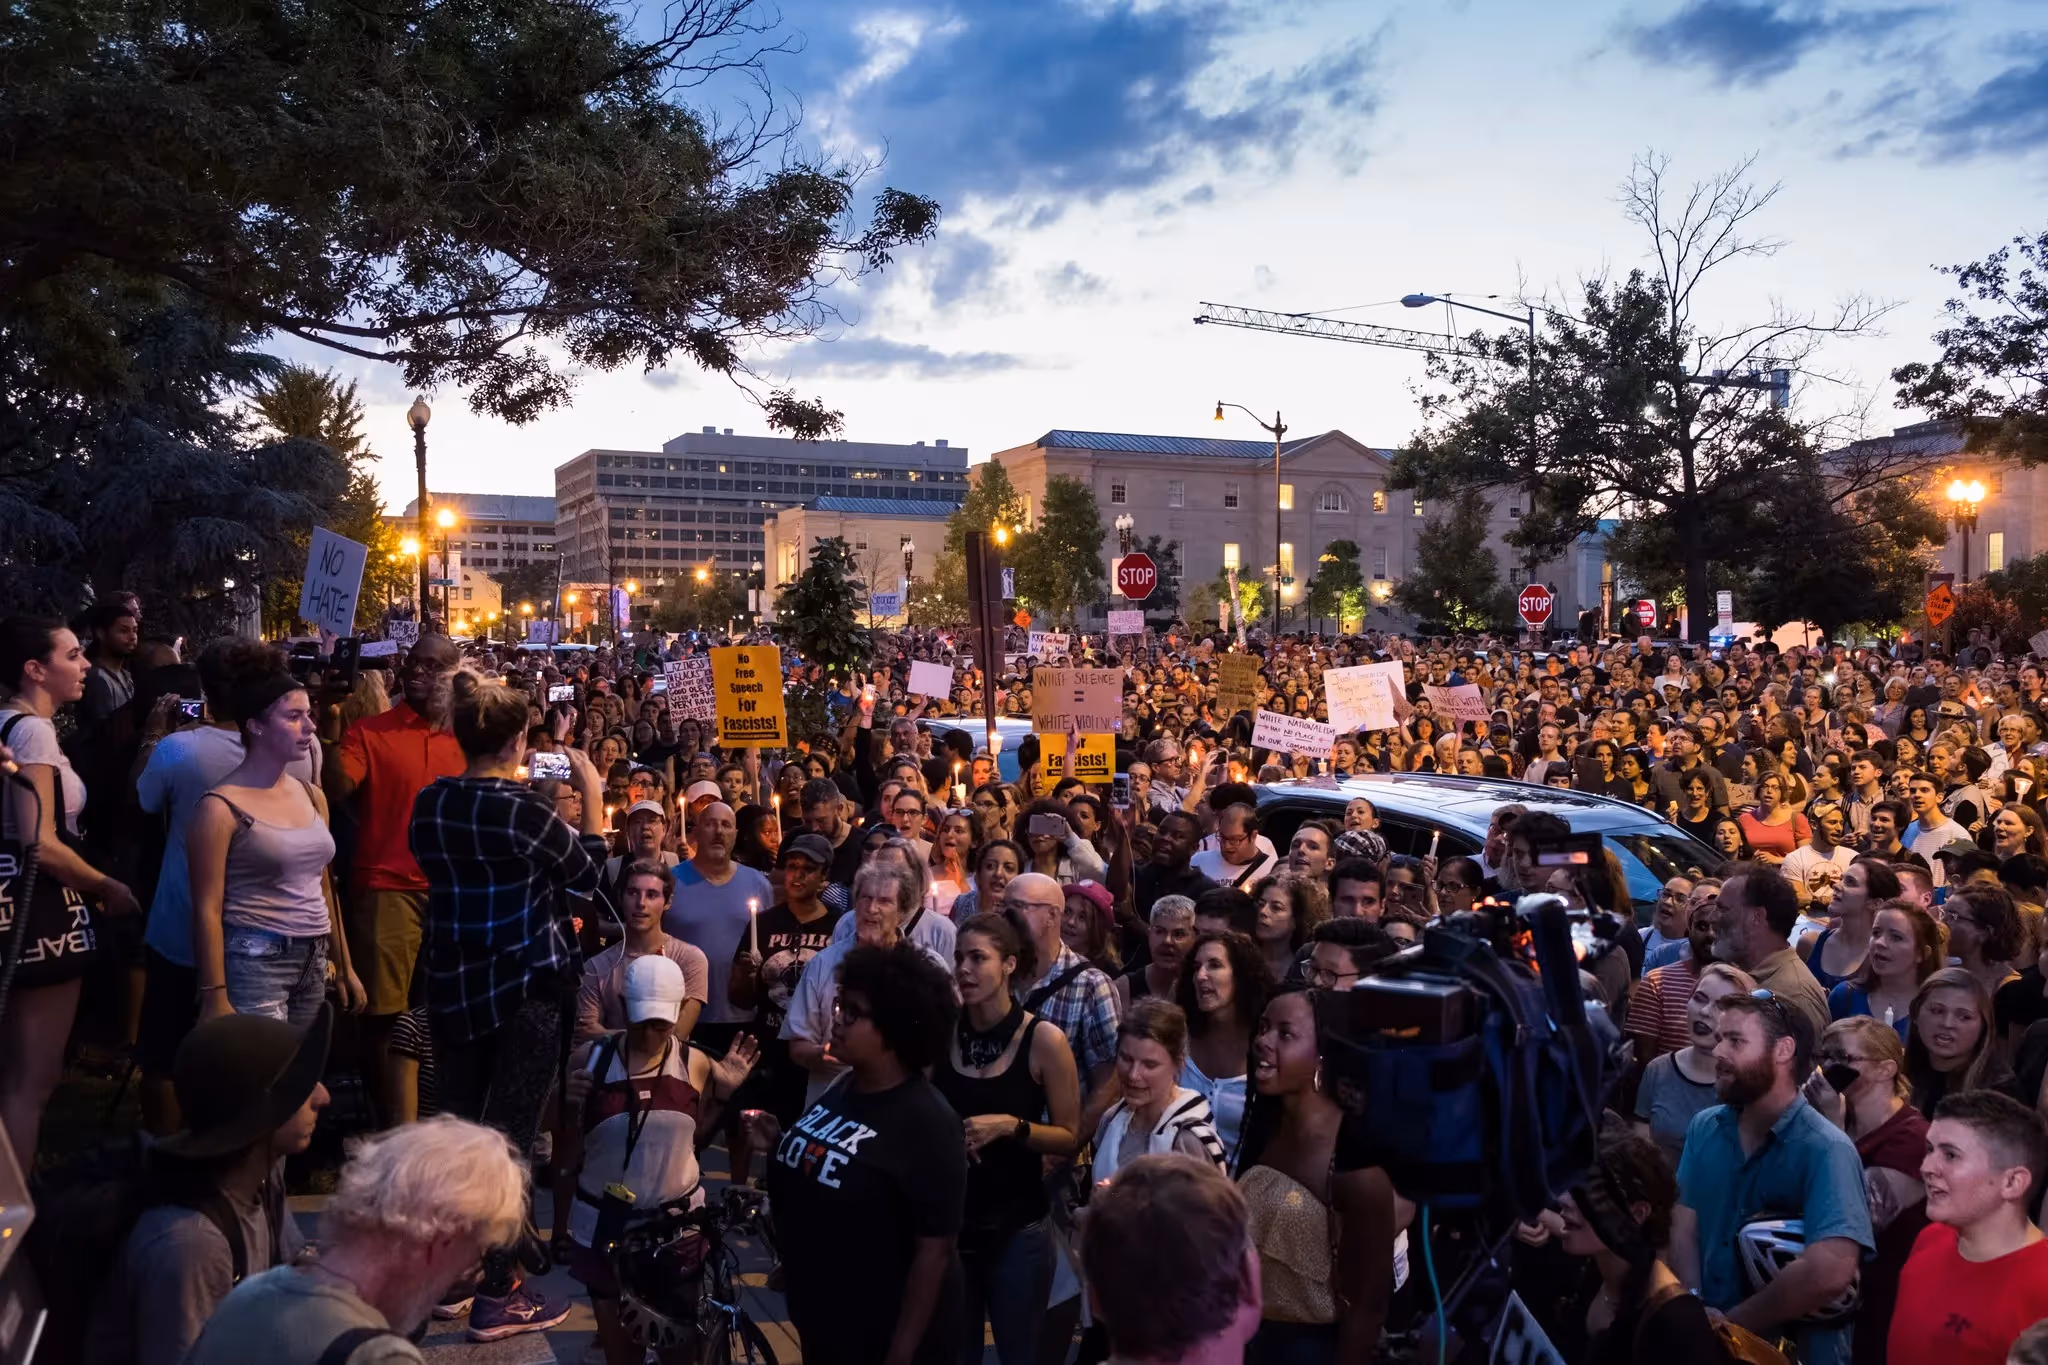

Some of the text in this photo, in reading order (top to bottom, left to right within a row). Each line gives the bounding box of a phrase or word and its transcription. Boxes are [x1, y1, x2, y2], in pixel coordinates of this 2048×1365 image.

[320, 541, 345, 577] NO
[1120, 568, 1153, 585] STOP
[308, 578, 349, 624] HATE
[1522, 597, 1549, 612] STOP
[737, 653, 750, 664] No
[664, 659, 705, 673] LAZINESS
[735, 668, 755, 678] Free
[1073, 671, 1115, 686] SILENCE
[1329, 672, 1351, 685] Just
[669, 688, 686, 696] GOOD
[730, 682, 763, 693] Speech
[1438, 687, 1452, 697] DC
[671, 697, 716, 709] VERY ROUG
[738, 698, 757, 712] For
[1460, 696, 1485, 707] WITH
[723, 716, 777, 730] Fascists!
[1037, 714, 1070, 732] WHITE
[1259, 712, 1336, 737] WHITE NATIONALISM
[1270, 725, 1280, 733] HAS
[1295, 730, 1314, 740] PLACE
[1257, 734, 1266, 742] IN
[1268, 737, 1282, 747] OUR
[795, 1104, 877, 1155] BLACK
